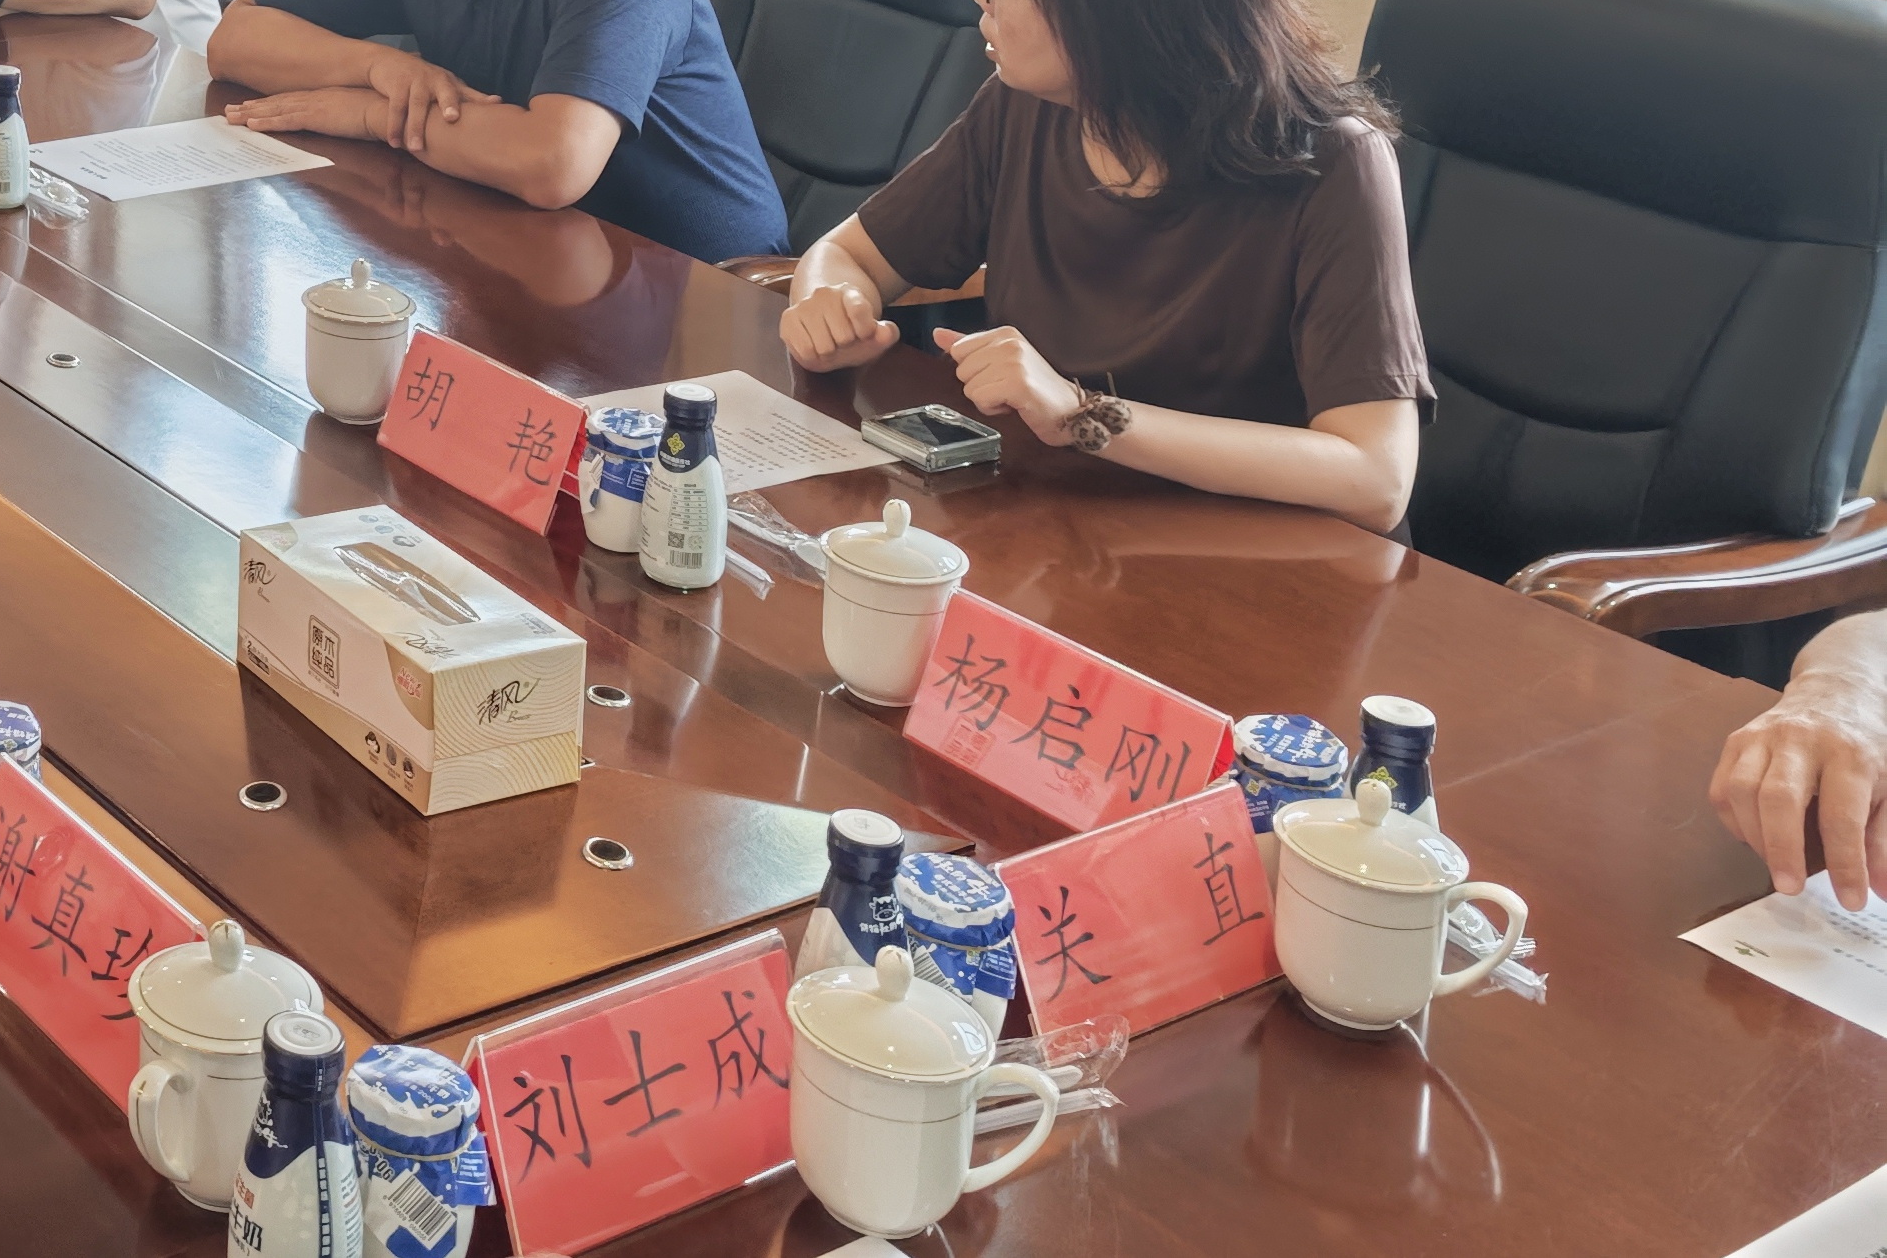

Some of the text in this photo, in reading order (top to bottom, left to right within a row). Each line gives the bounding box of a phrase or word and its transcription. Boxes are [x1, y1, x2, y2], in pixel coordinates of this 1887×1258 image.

[406, 357, 555, 488] 胡艳
[933, 634, 1193, 814] 杨启刚
[1035, 833, 1266, 1003] 关直
[503, 989, 792, 1184] 刘士成
